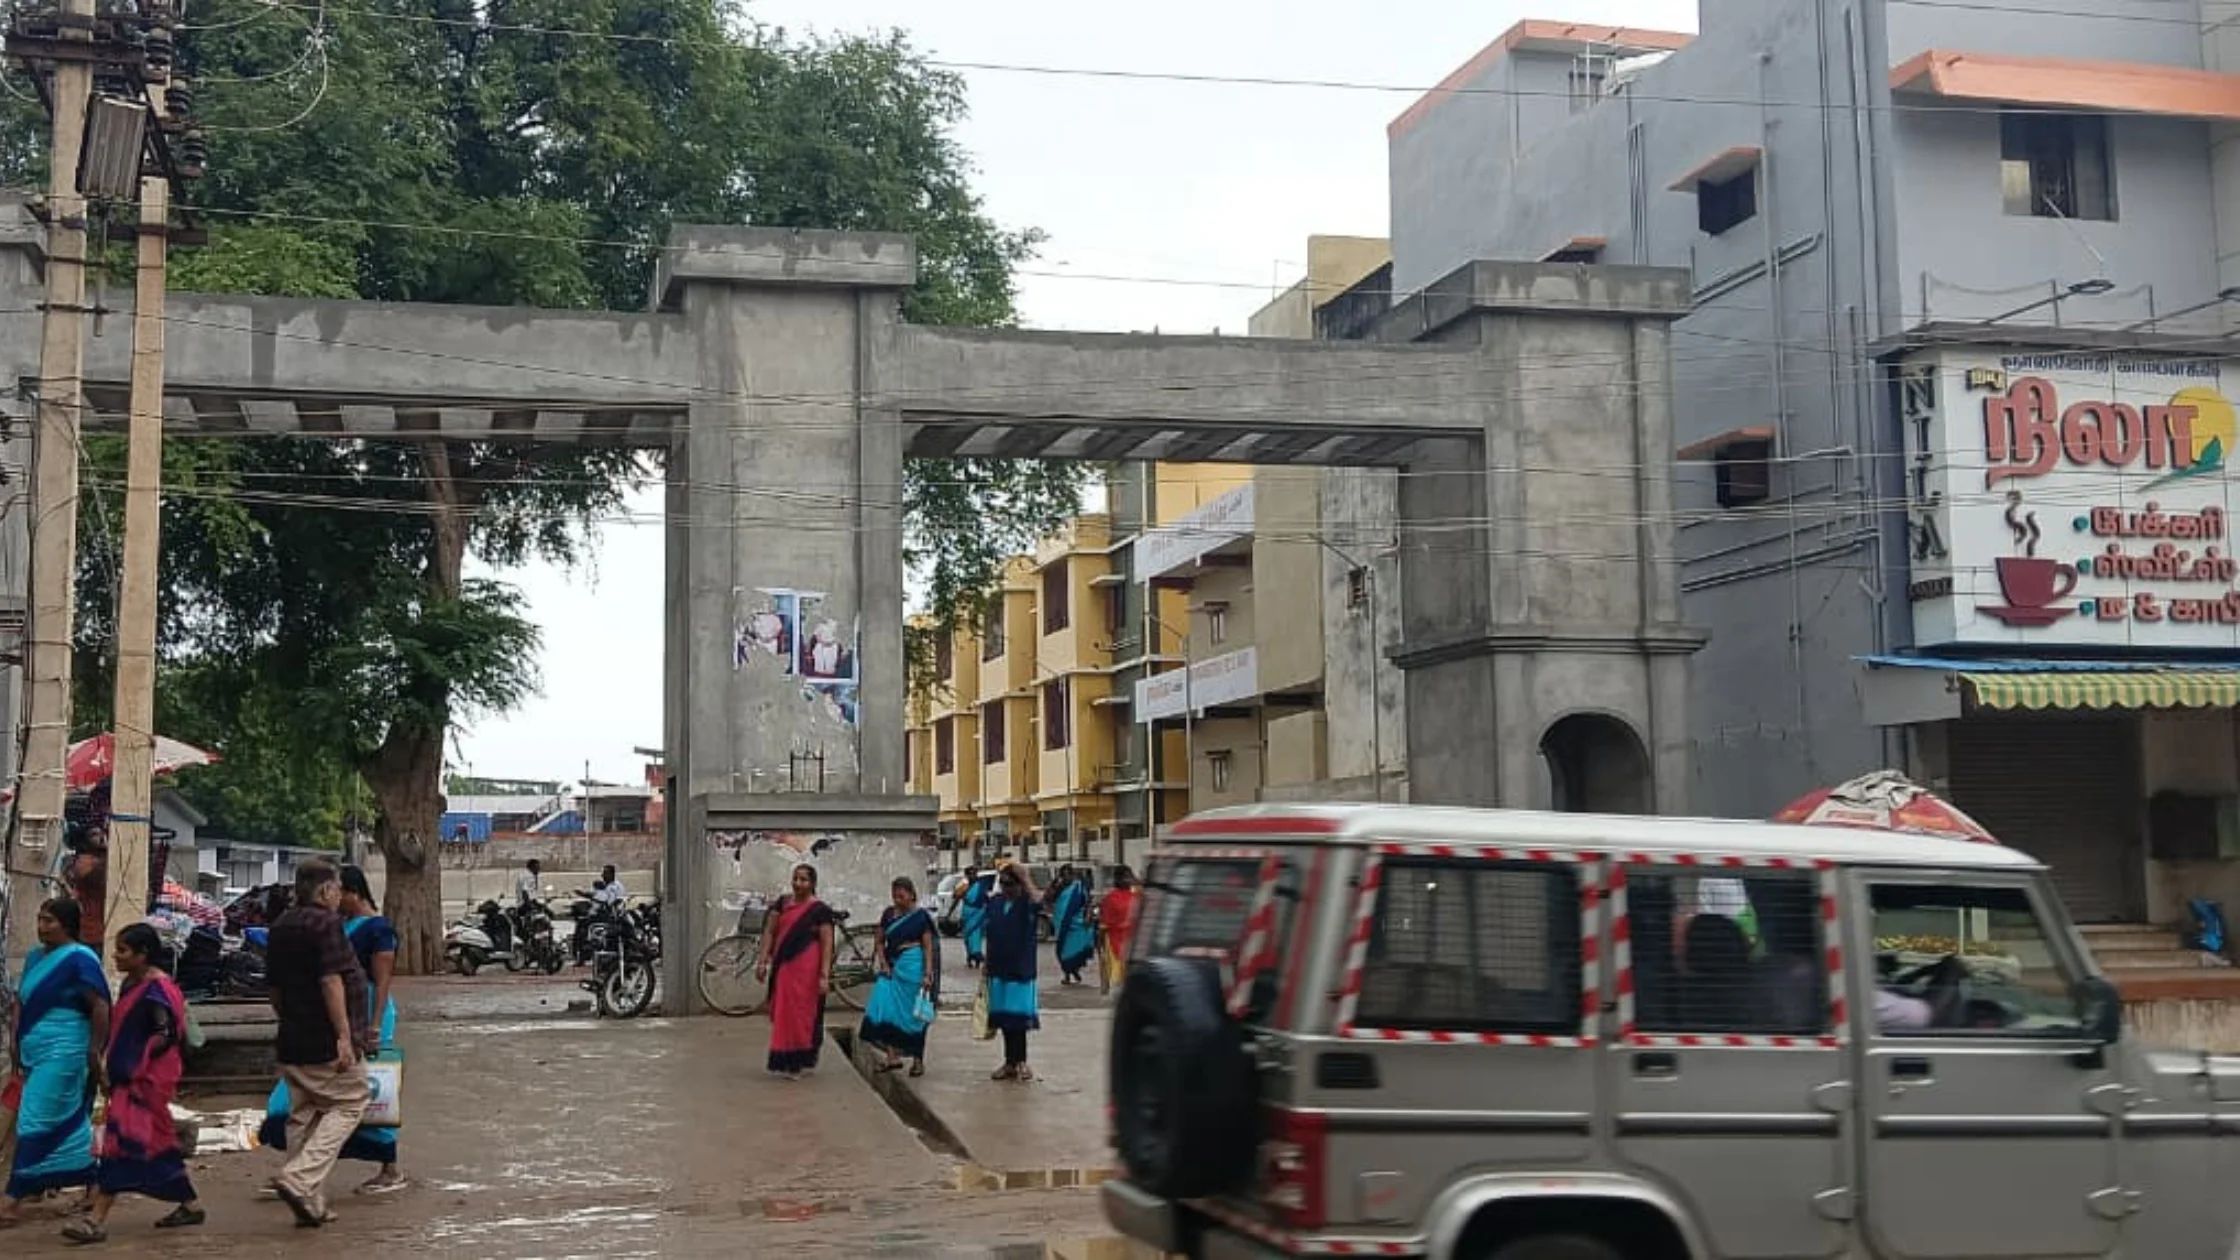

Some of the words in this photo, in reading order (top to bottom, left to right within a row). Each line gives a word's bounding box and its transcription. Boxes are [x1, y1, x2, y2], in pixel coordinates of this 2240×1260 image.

[1982, 376, 2199, 491] நிலா
[2090, 501, 2225, 539] பேக்கரி
[2093, 543, 2239, 582] ஸ்வீட்ஸ்
[2133, 592, 2163, 622] &
